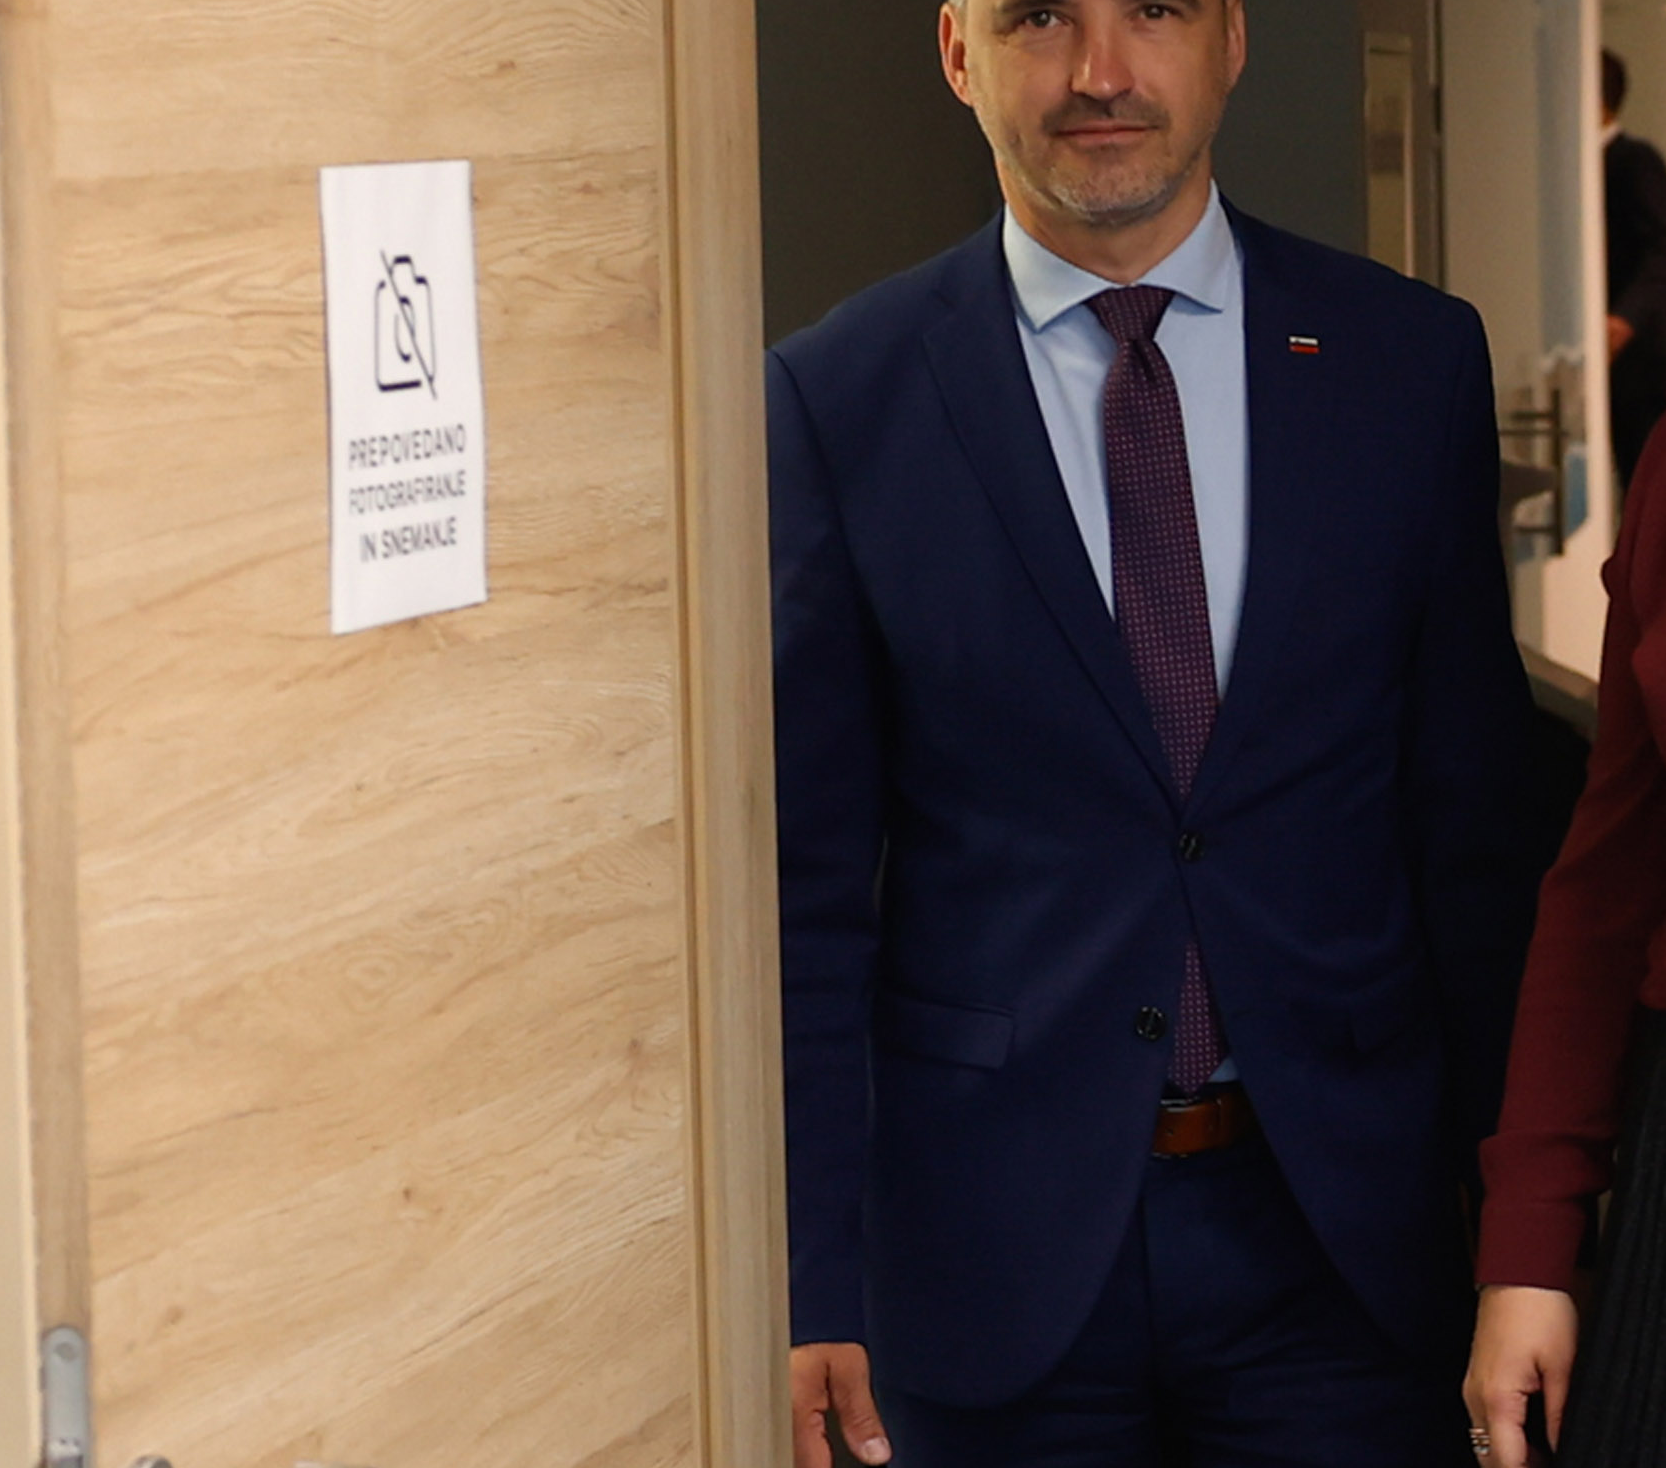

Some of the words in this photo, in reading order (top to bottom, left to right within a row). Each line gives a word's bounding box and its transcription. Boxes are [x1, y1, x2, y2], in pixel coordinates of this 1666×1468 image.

[348, 422, 466, 470] PREPOVEDANO
[348, 469, 466, 515] FOTOGRAFIRANJE
[359, 532, 377, 562] IN
[381, 516, 457, 558] SNEMANJE
